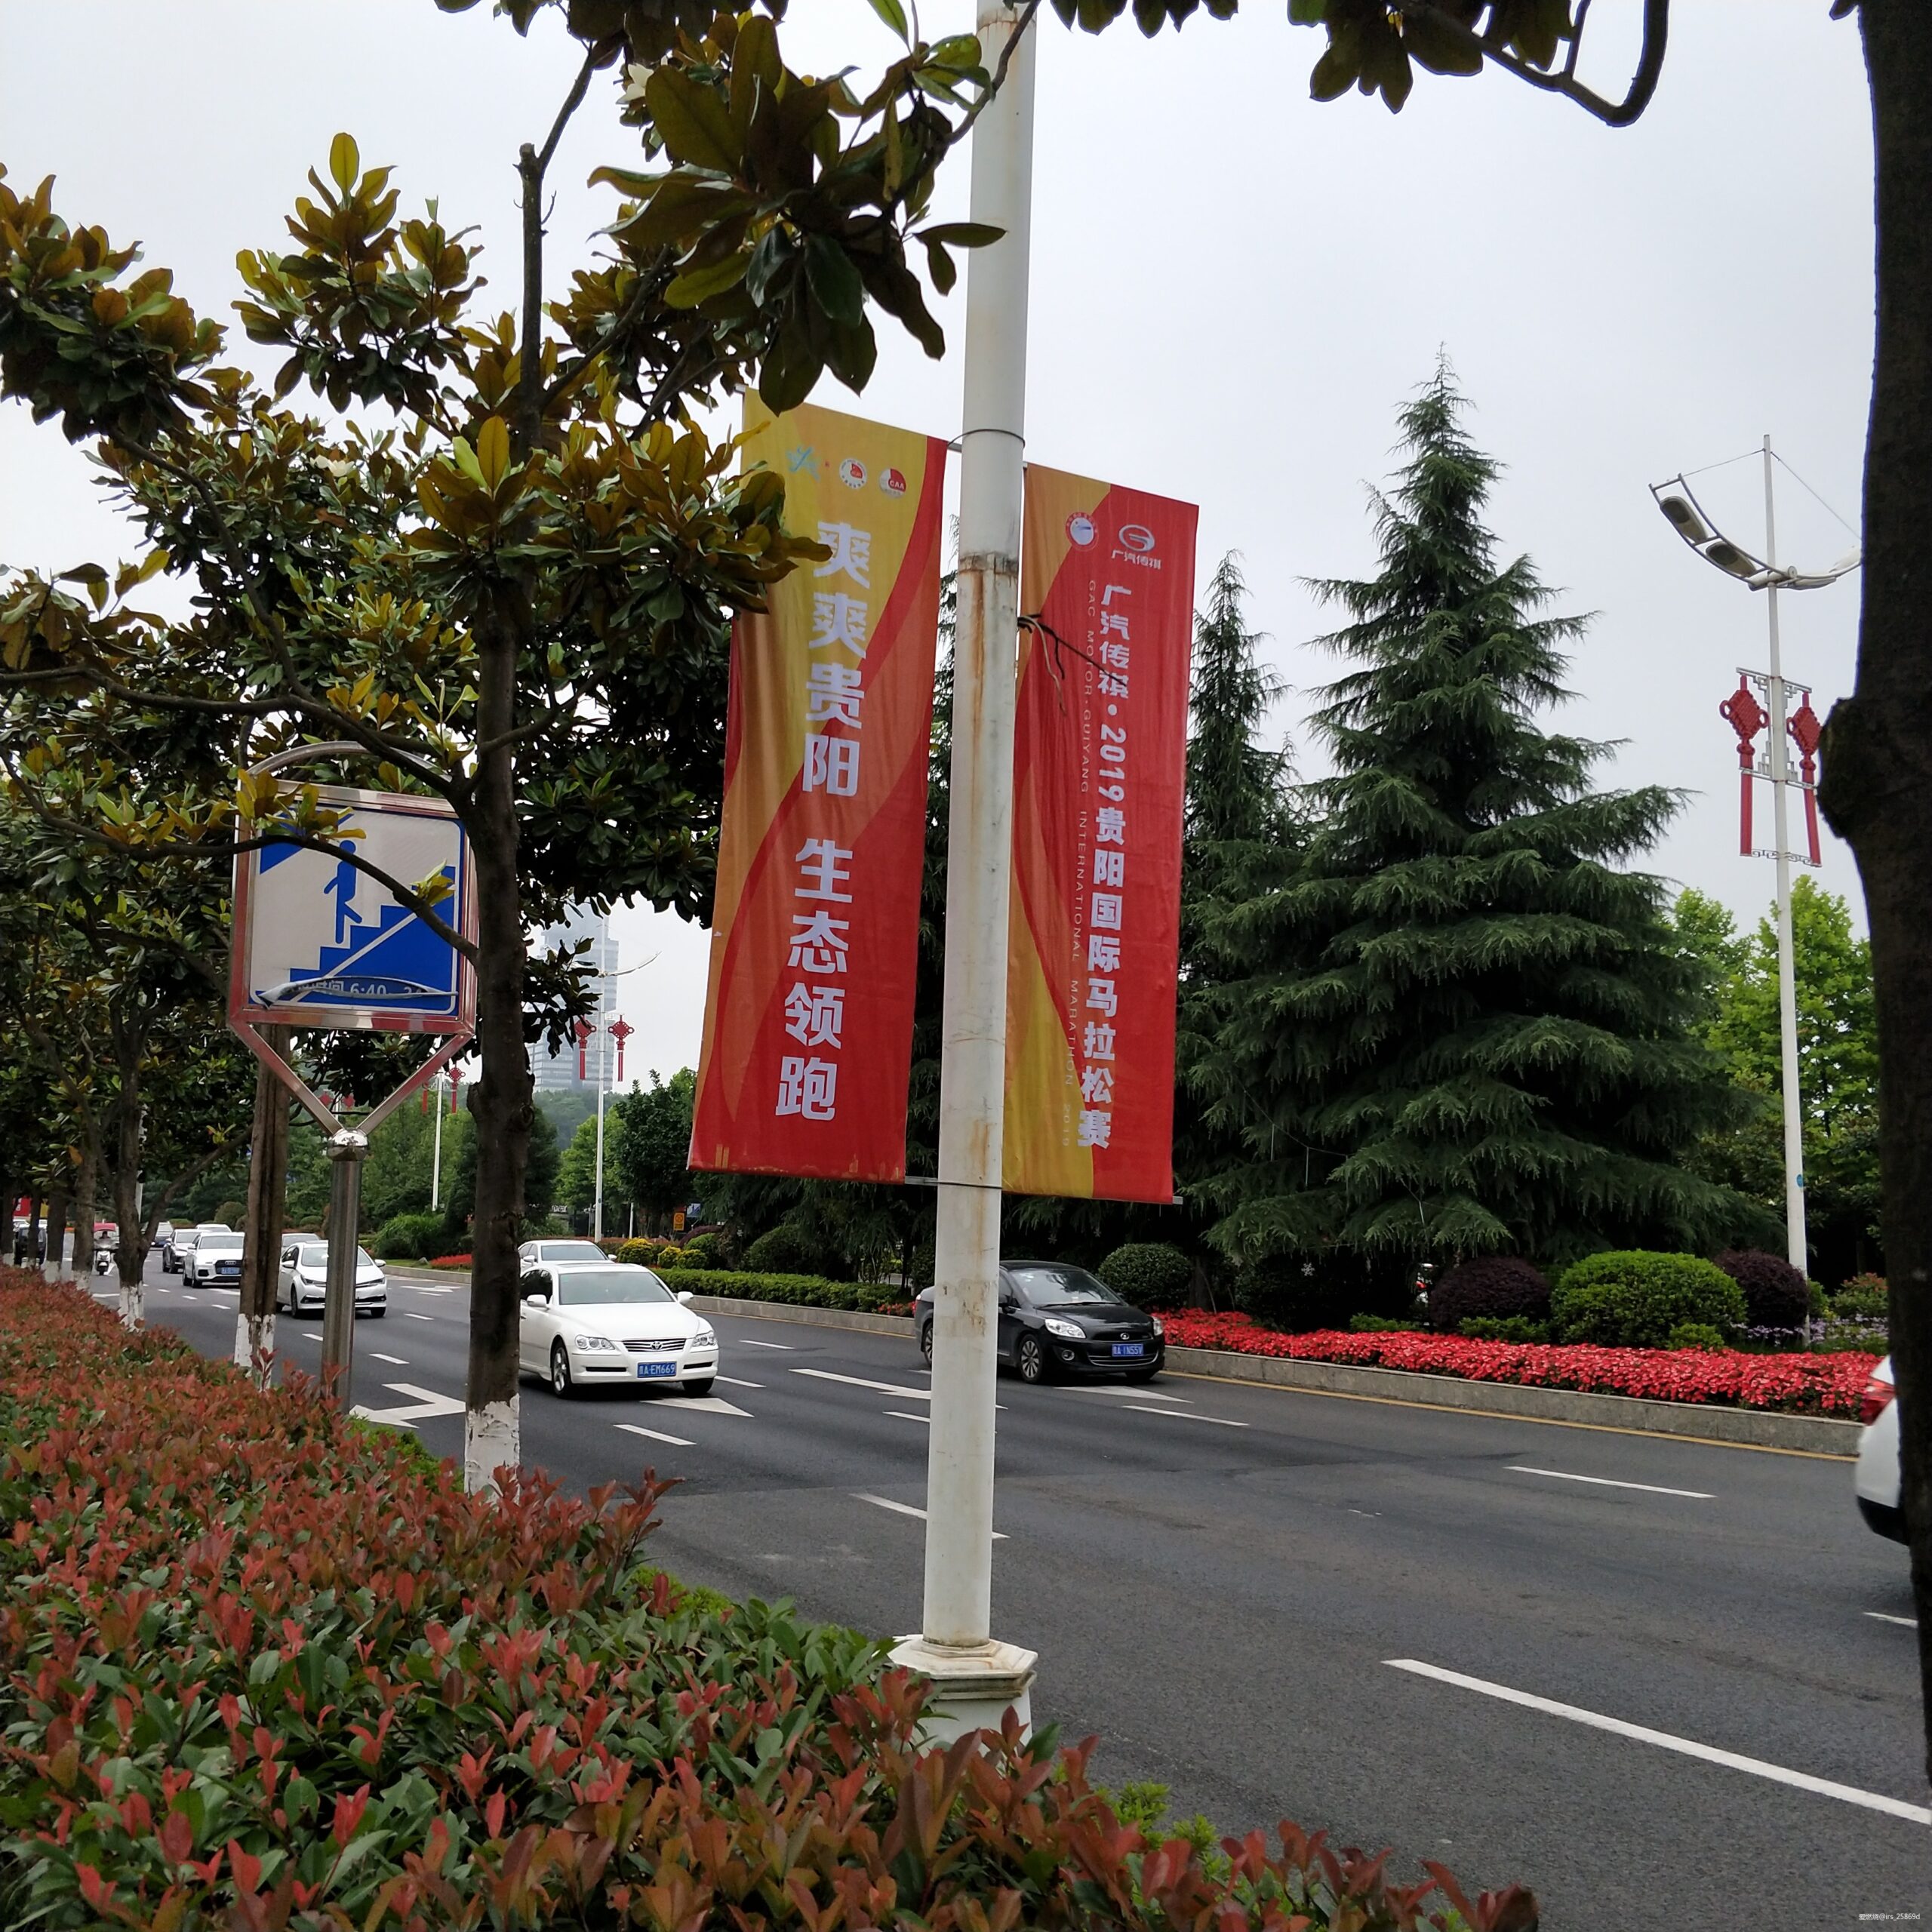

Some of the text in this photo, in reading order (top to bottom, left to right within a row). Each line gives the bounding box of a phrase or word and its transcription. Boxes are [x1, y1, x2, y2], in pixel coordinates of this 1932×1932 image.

[1088, 580, 1097, 617] GAC
[775, 521, 872, 1121] 爽爽贵阳 生态领跑
[1072, 810, 1088, 961] INTERNATIONAL
[1066, 980, 1079, 1085] MARATHON
